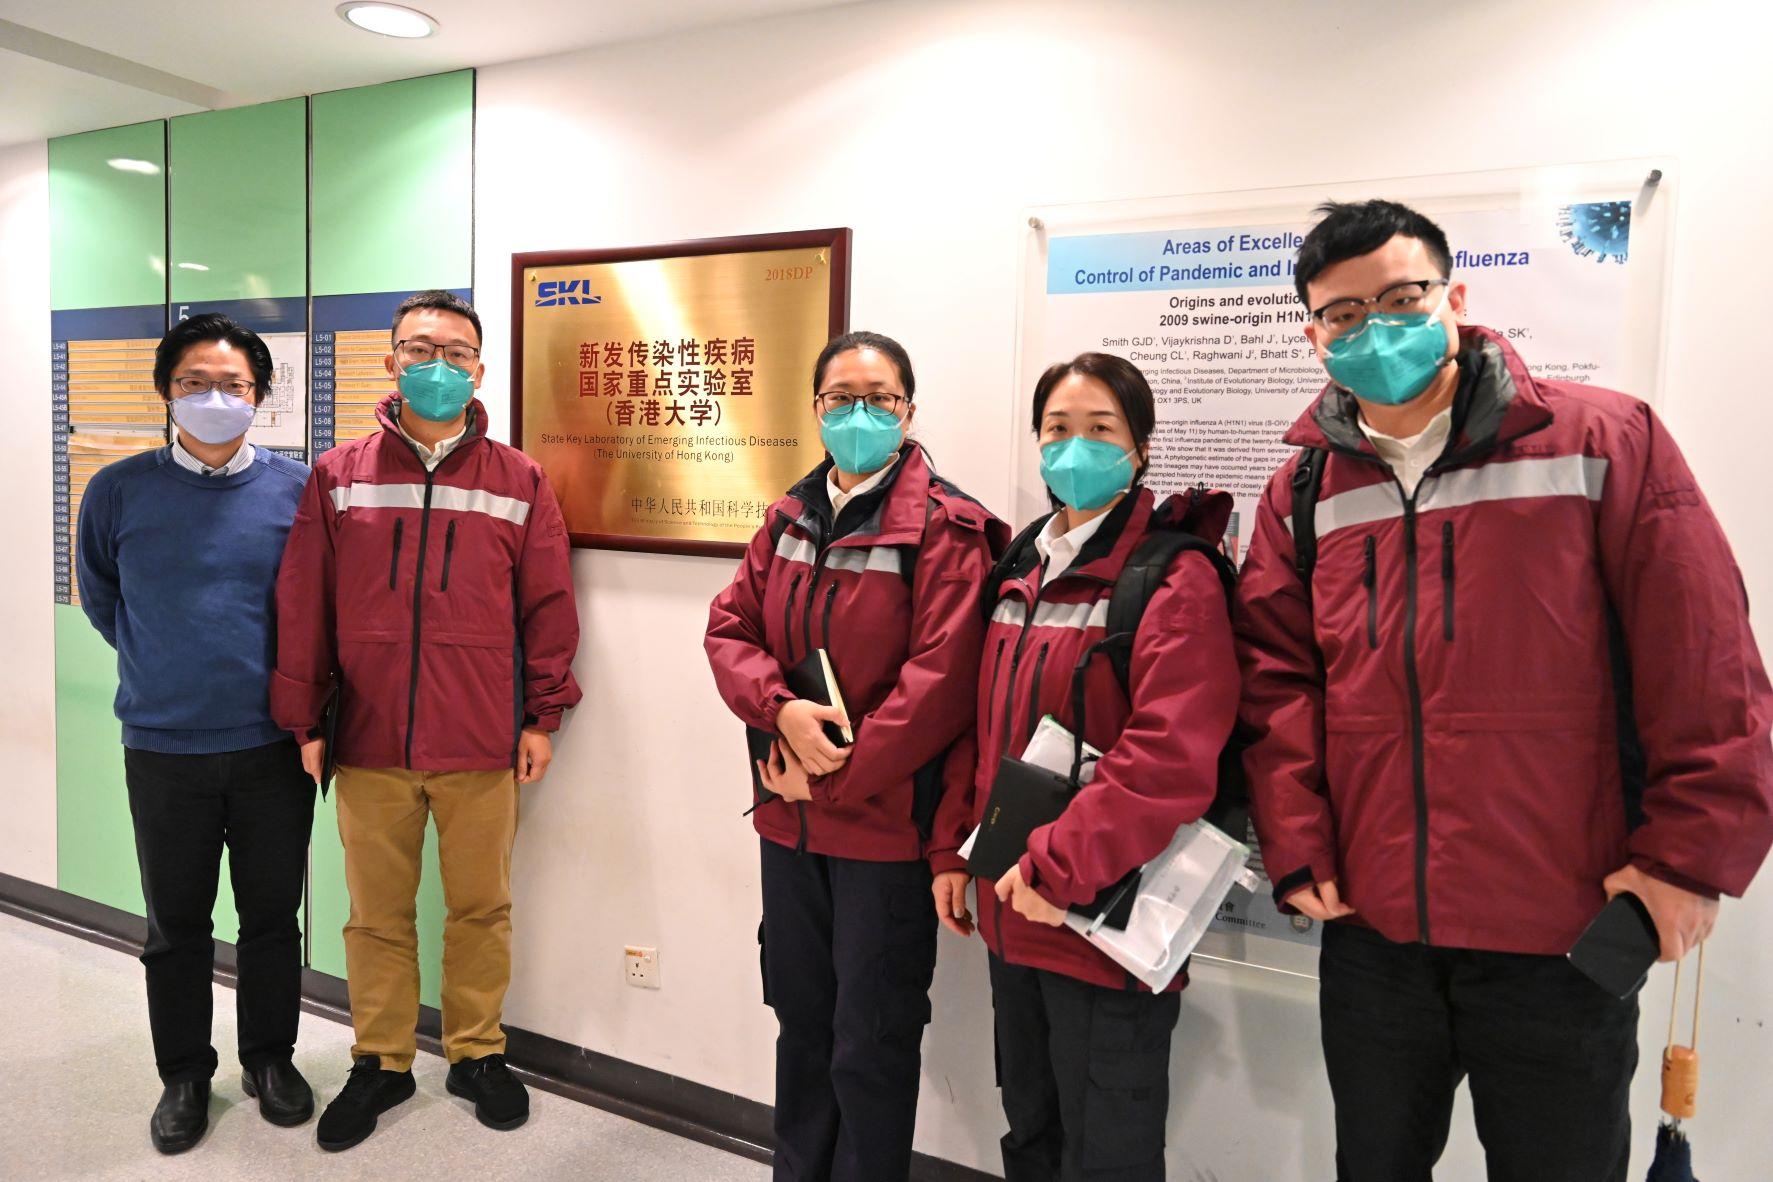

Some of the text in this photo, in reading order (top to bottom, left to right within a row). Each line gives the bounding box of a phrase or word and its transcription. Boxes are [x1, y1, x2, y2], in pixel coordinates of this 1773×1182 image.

[1162, 239, 1211, 255] Areas
[1217, 235, 1235, 252] of
[765, 265, 813, 281] 2018DP
[1075, 267, 1133, 285] Control
[1138, 266, 1155, 282] of
[1159, 262, 1243, 282] Pandemic
[1248, 260, 1281, 277] and
[535, 280, 602, 306] SKL
[1169, 295, 1215, 311] Origins
[1219, 294, 1243, 307] and
[1160, 313, 1188, 327] 2009
[1192, 312, 1272, 327] swine-origin
[315, 334, 332, 342] L5-01
[1102, 337, 1128, 346] Smith
[1161, 336, 1220, 347] Vijaykrishna
[1240, 334, 1264, 344] Bahl
[579, 337, 755, 368] 新发传染性疾病
[1129, 351, 1167, 362] Cheung
[1193, 349, 1243, 361] Raghwani
[1260, 349, 1288, 359] Bhatt
[315, 358, 332, 366] L5-03
[1228, 367, 1268, 375] Department
[579, 368, 754, 398] 国家重点实验室
[1267, 377, 1295, 385] Biology,
[1183, 387, 1224, 395] Evolutionary
[1226, 387, 1252, 395] Biology,
[1254, 387, 1289, 395] University
[606, 399, 721, 427] (香港大学)
[1224, 419, 1247, 427] (H1N1)
[315, 441, 332, 449] L5-10
[541, 433, 799, 447] State Key Laboratory of Emerging Infectious Diseases
[593, 448, 734, 463] (The University of Hong Kong)
[1215, 911, 1266, 929] Committee
